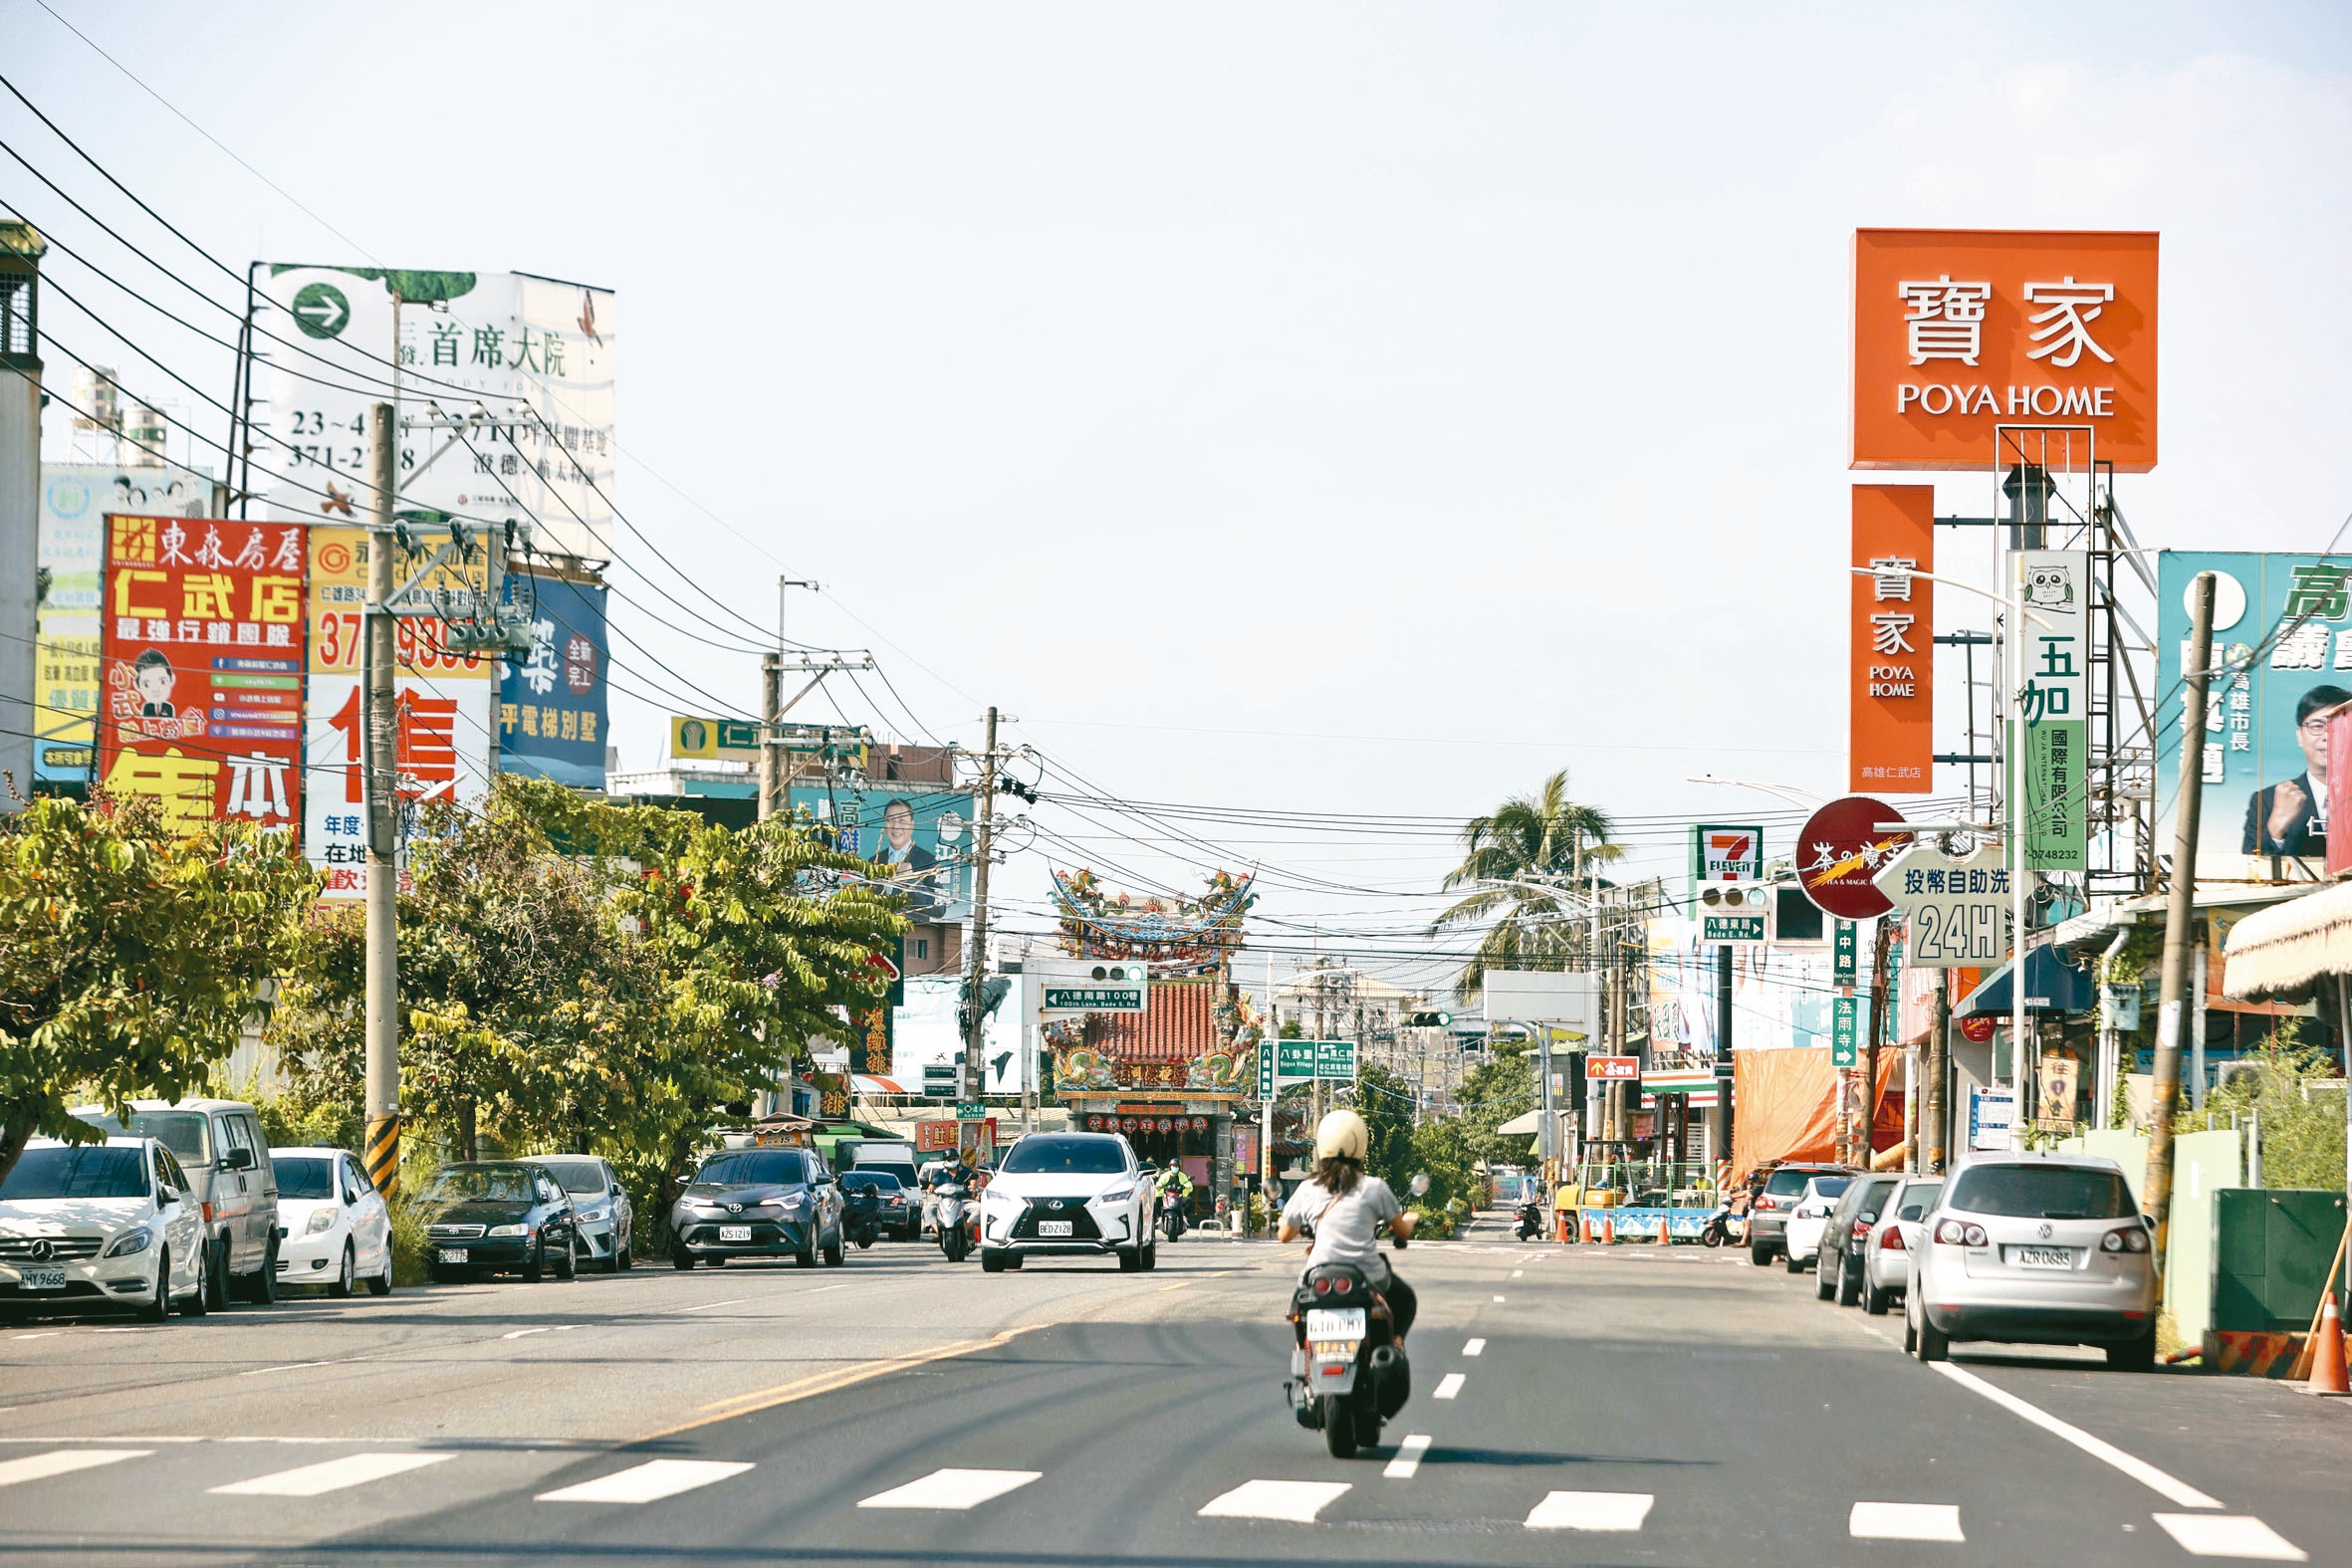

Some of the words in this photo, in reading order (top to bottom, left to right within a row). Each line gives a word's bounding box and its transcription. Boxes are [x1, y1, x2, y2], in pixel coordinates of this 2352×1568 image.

[1898, 275, 2115, 367] 寶家
[427, 321, 566, 376] 首席大院
[1897, 383, 2000, 414] POYA
[2007, 384, 2115, 416] HOME
[159, 520, 302, 570] 東森房屋
[115, 568, 301, 624] 仁武店
[1869, 556, 1917, 655] 寶家
[117, 617, 291, 646] 最強行銷團隊
[1869, 666, 1915, 680] POYA
[1869, 683, 1915, 697] HOME
[2021, 636, 2080, 728] 五加
[2229, 672, 2250, 752] 高雄市長
[1862, 767, 1922, 779] 高雄仁武店
[2051, 730, 2068, 838] 國際有限公司
[1905, 868, 2009, 895] 投幣自助洗
[1707, 919, 1751, 930] 八德東路
[1918, 904, 1998, 959] 24H
[1837, 1001, 1852, 1047] 法雨寺
